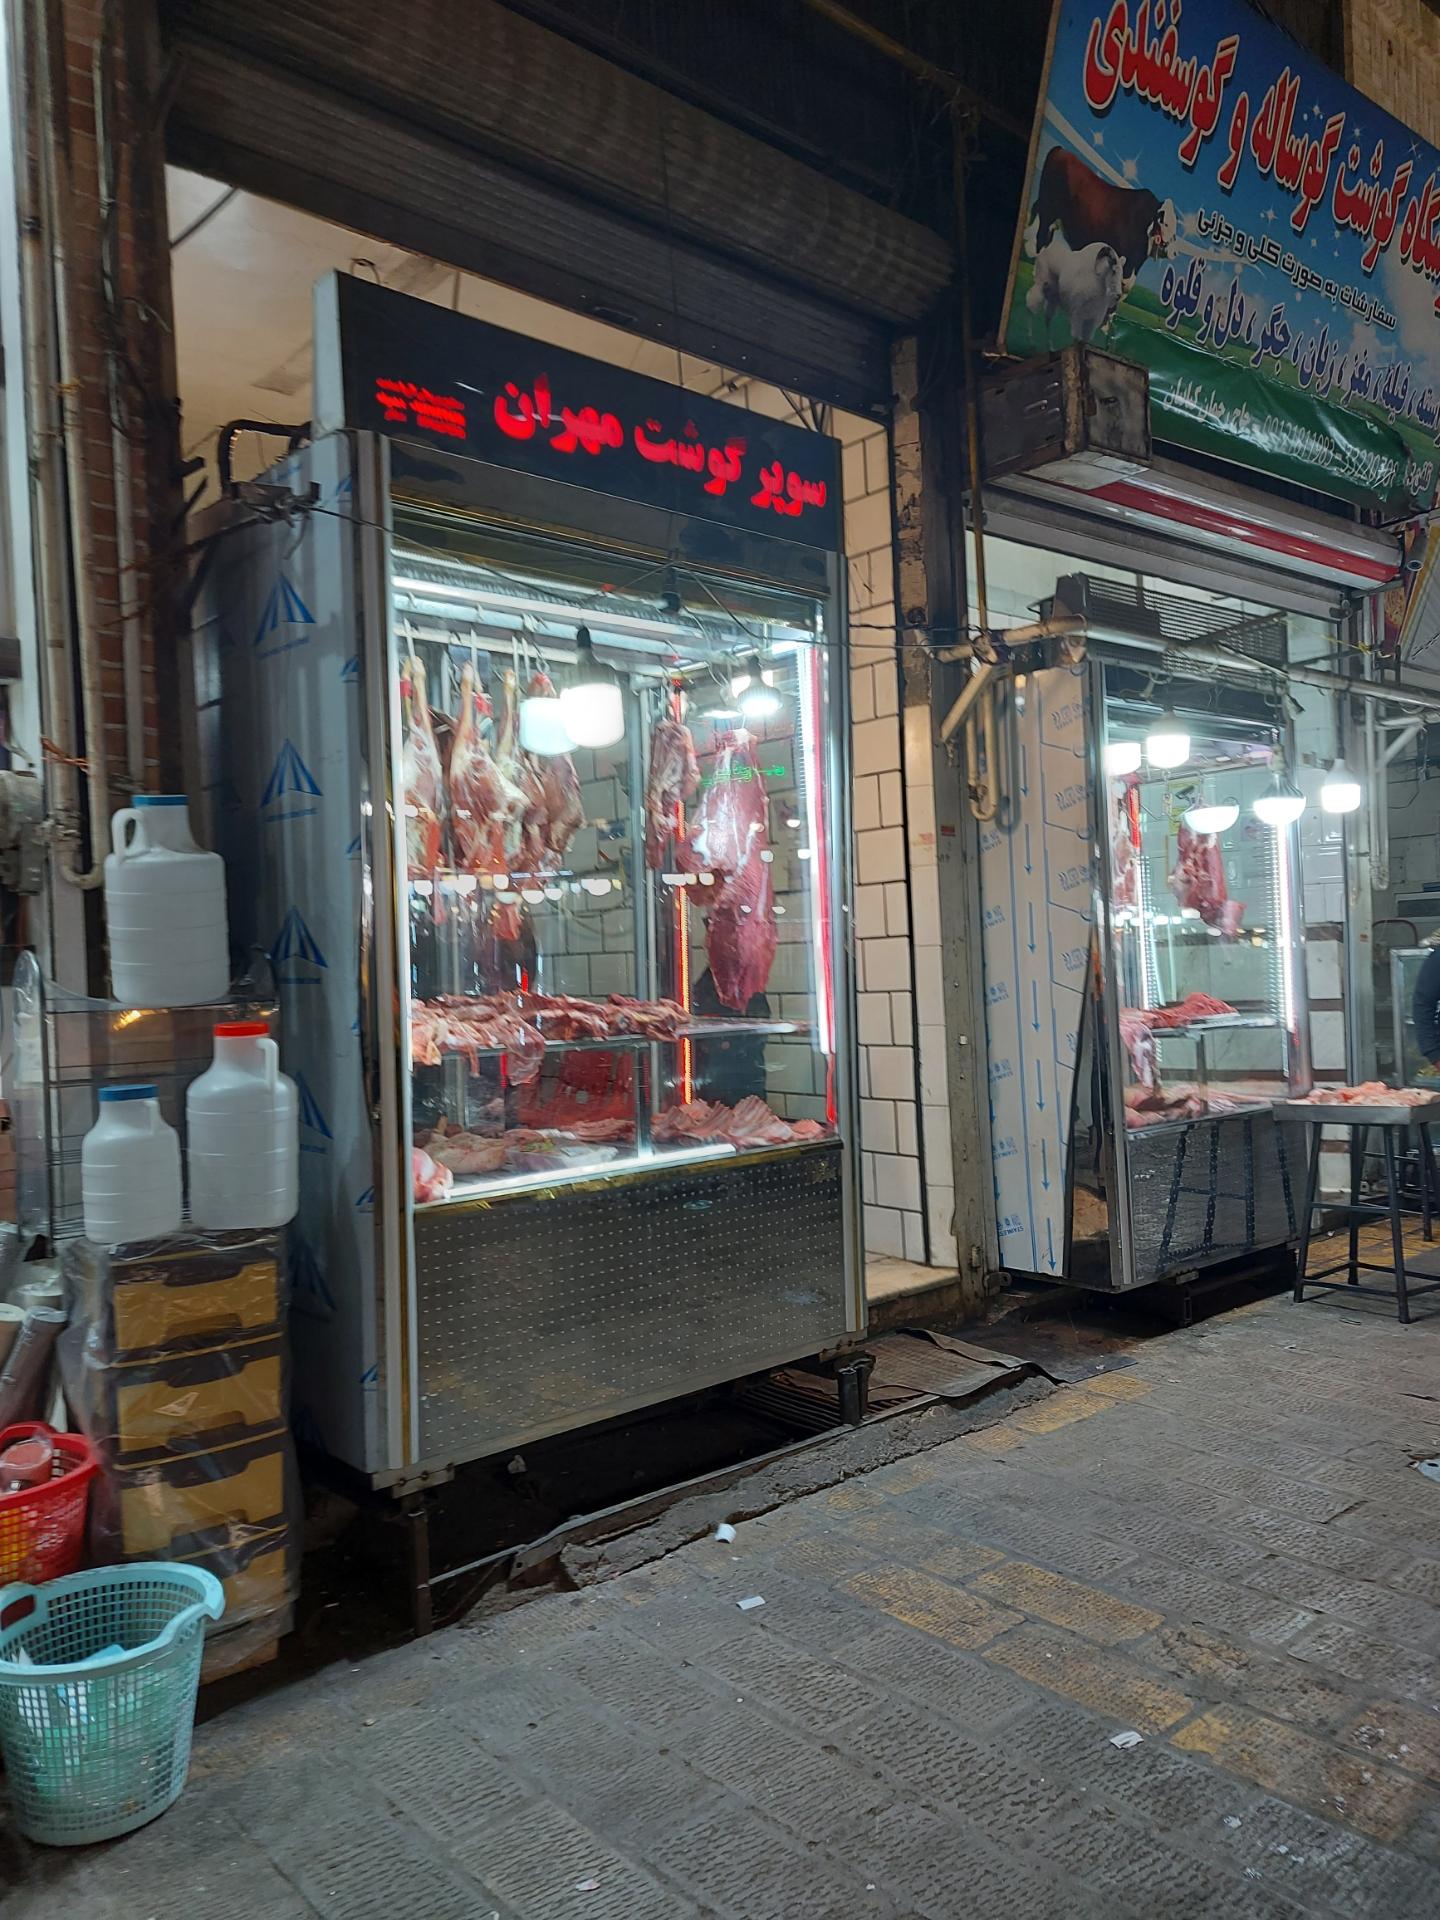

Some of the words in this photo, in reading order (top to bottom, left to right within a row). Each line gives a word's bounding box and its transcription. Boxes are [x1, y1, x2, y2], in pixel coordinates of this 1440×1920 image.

[1083, 0, 1240, 166] گوسفندی
[1217, 91, 1250, 190] و
[1249, 65, 1346, 232] گوساله
[1233, 230, 1246, 256] و
[1331, 137, 1413, 273] گوشت
[1247, 234, 1283, 267] کلی
[1281, 251, 1324, 290] صورت
[1160, 255, 1206, 331] قلوه
[1195, 291, 1215, 345] و
[1212, 274, 1245, 350] دل
[1324, 279, 1339, 305] به
[1340, 283, 1397, 331] سفارشات
[493, 373, 624, 456] مهران
[633, 418, 748, 497] گوشت
[750, 460, 827, 517] سوپر
